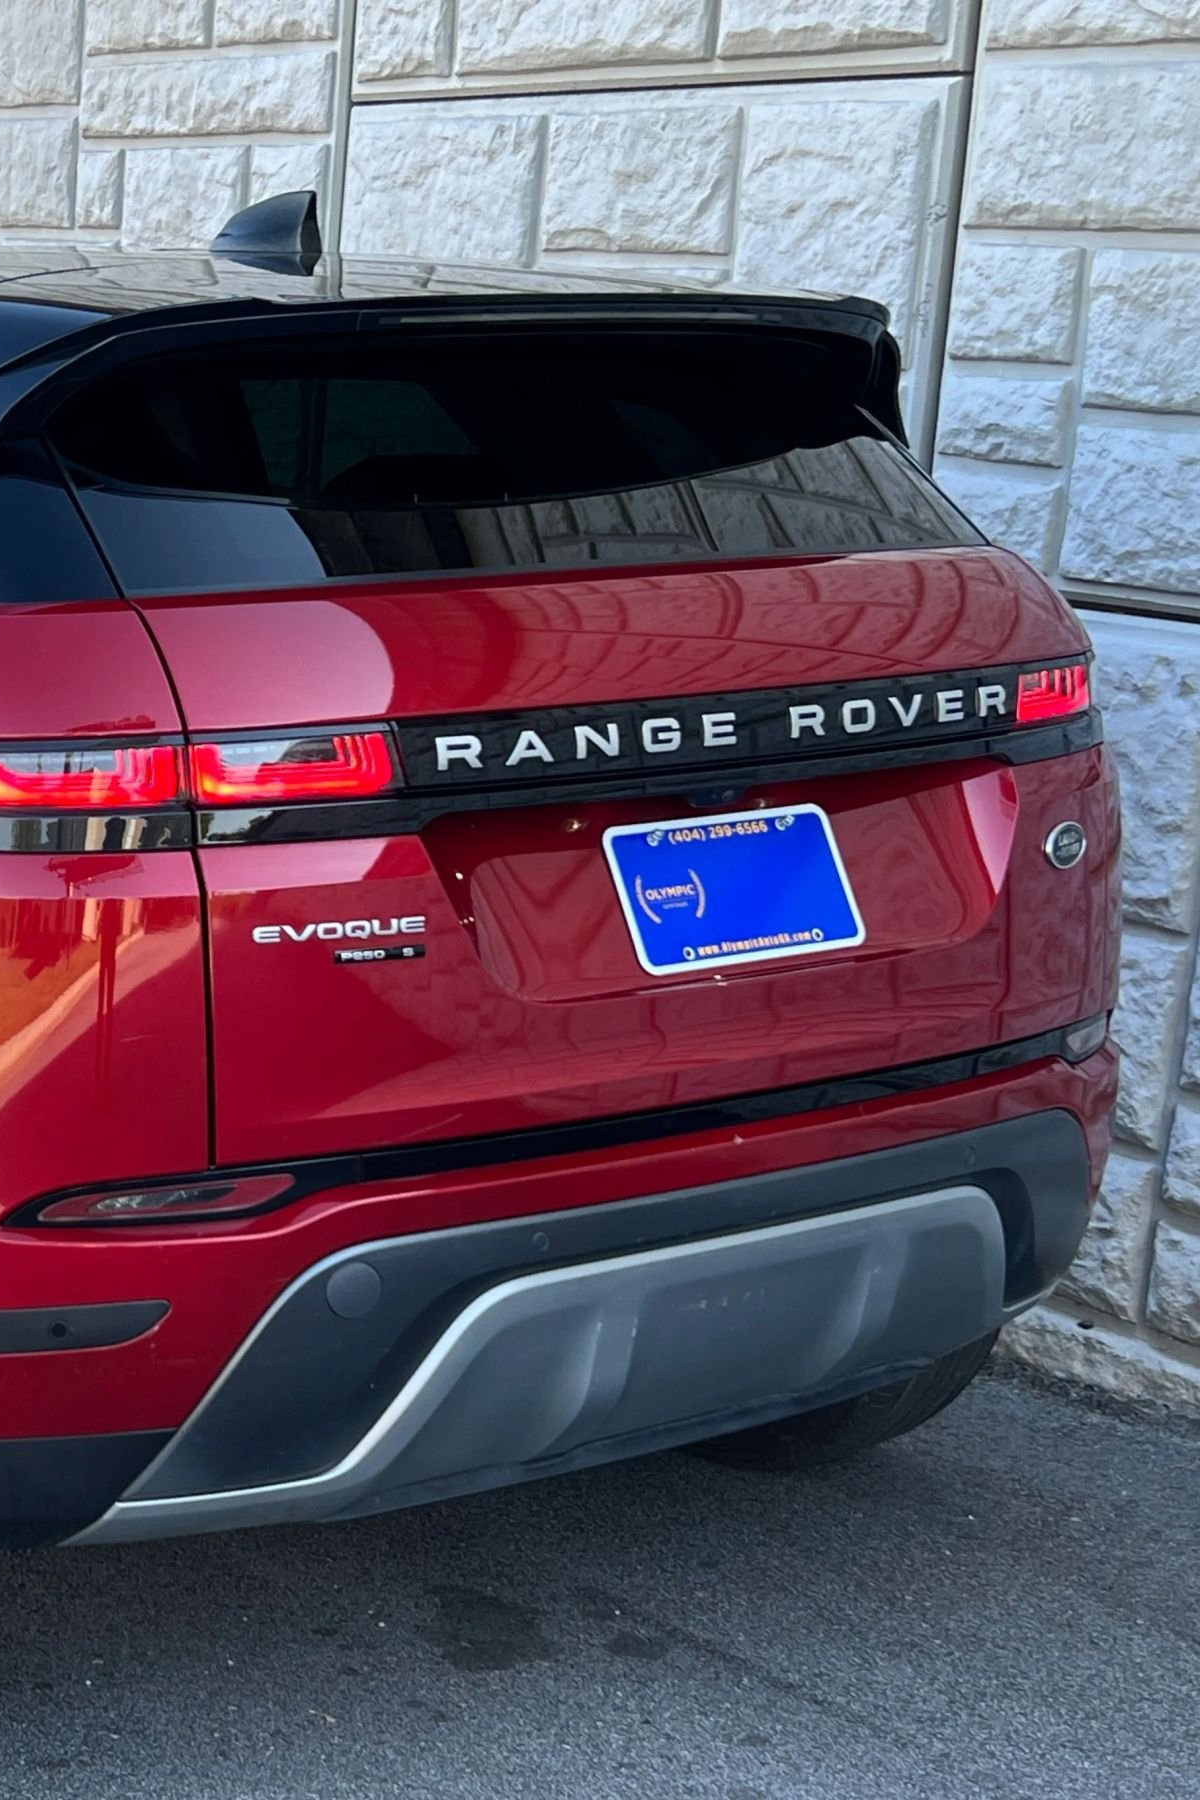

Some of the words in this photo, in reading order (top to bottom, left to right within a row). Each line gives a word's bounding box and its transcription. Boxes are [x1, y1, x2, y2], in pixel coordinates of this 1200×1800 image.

[434, 711, 738, 771] RANGE
[788, 685, 1008, 739] ROVER
[668, 828, 706, 845] (404)
[707, 820, 768, 839] 299-6566
[645, 884, 696, 901] OLYMPIC
[253, 916, 426, 944] EVOQUE
[341, 949, 386, 962] P250
[402, 947, 415, 957] S
